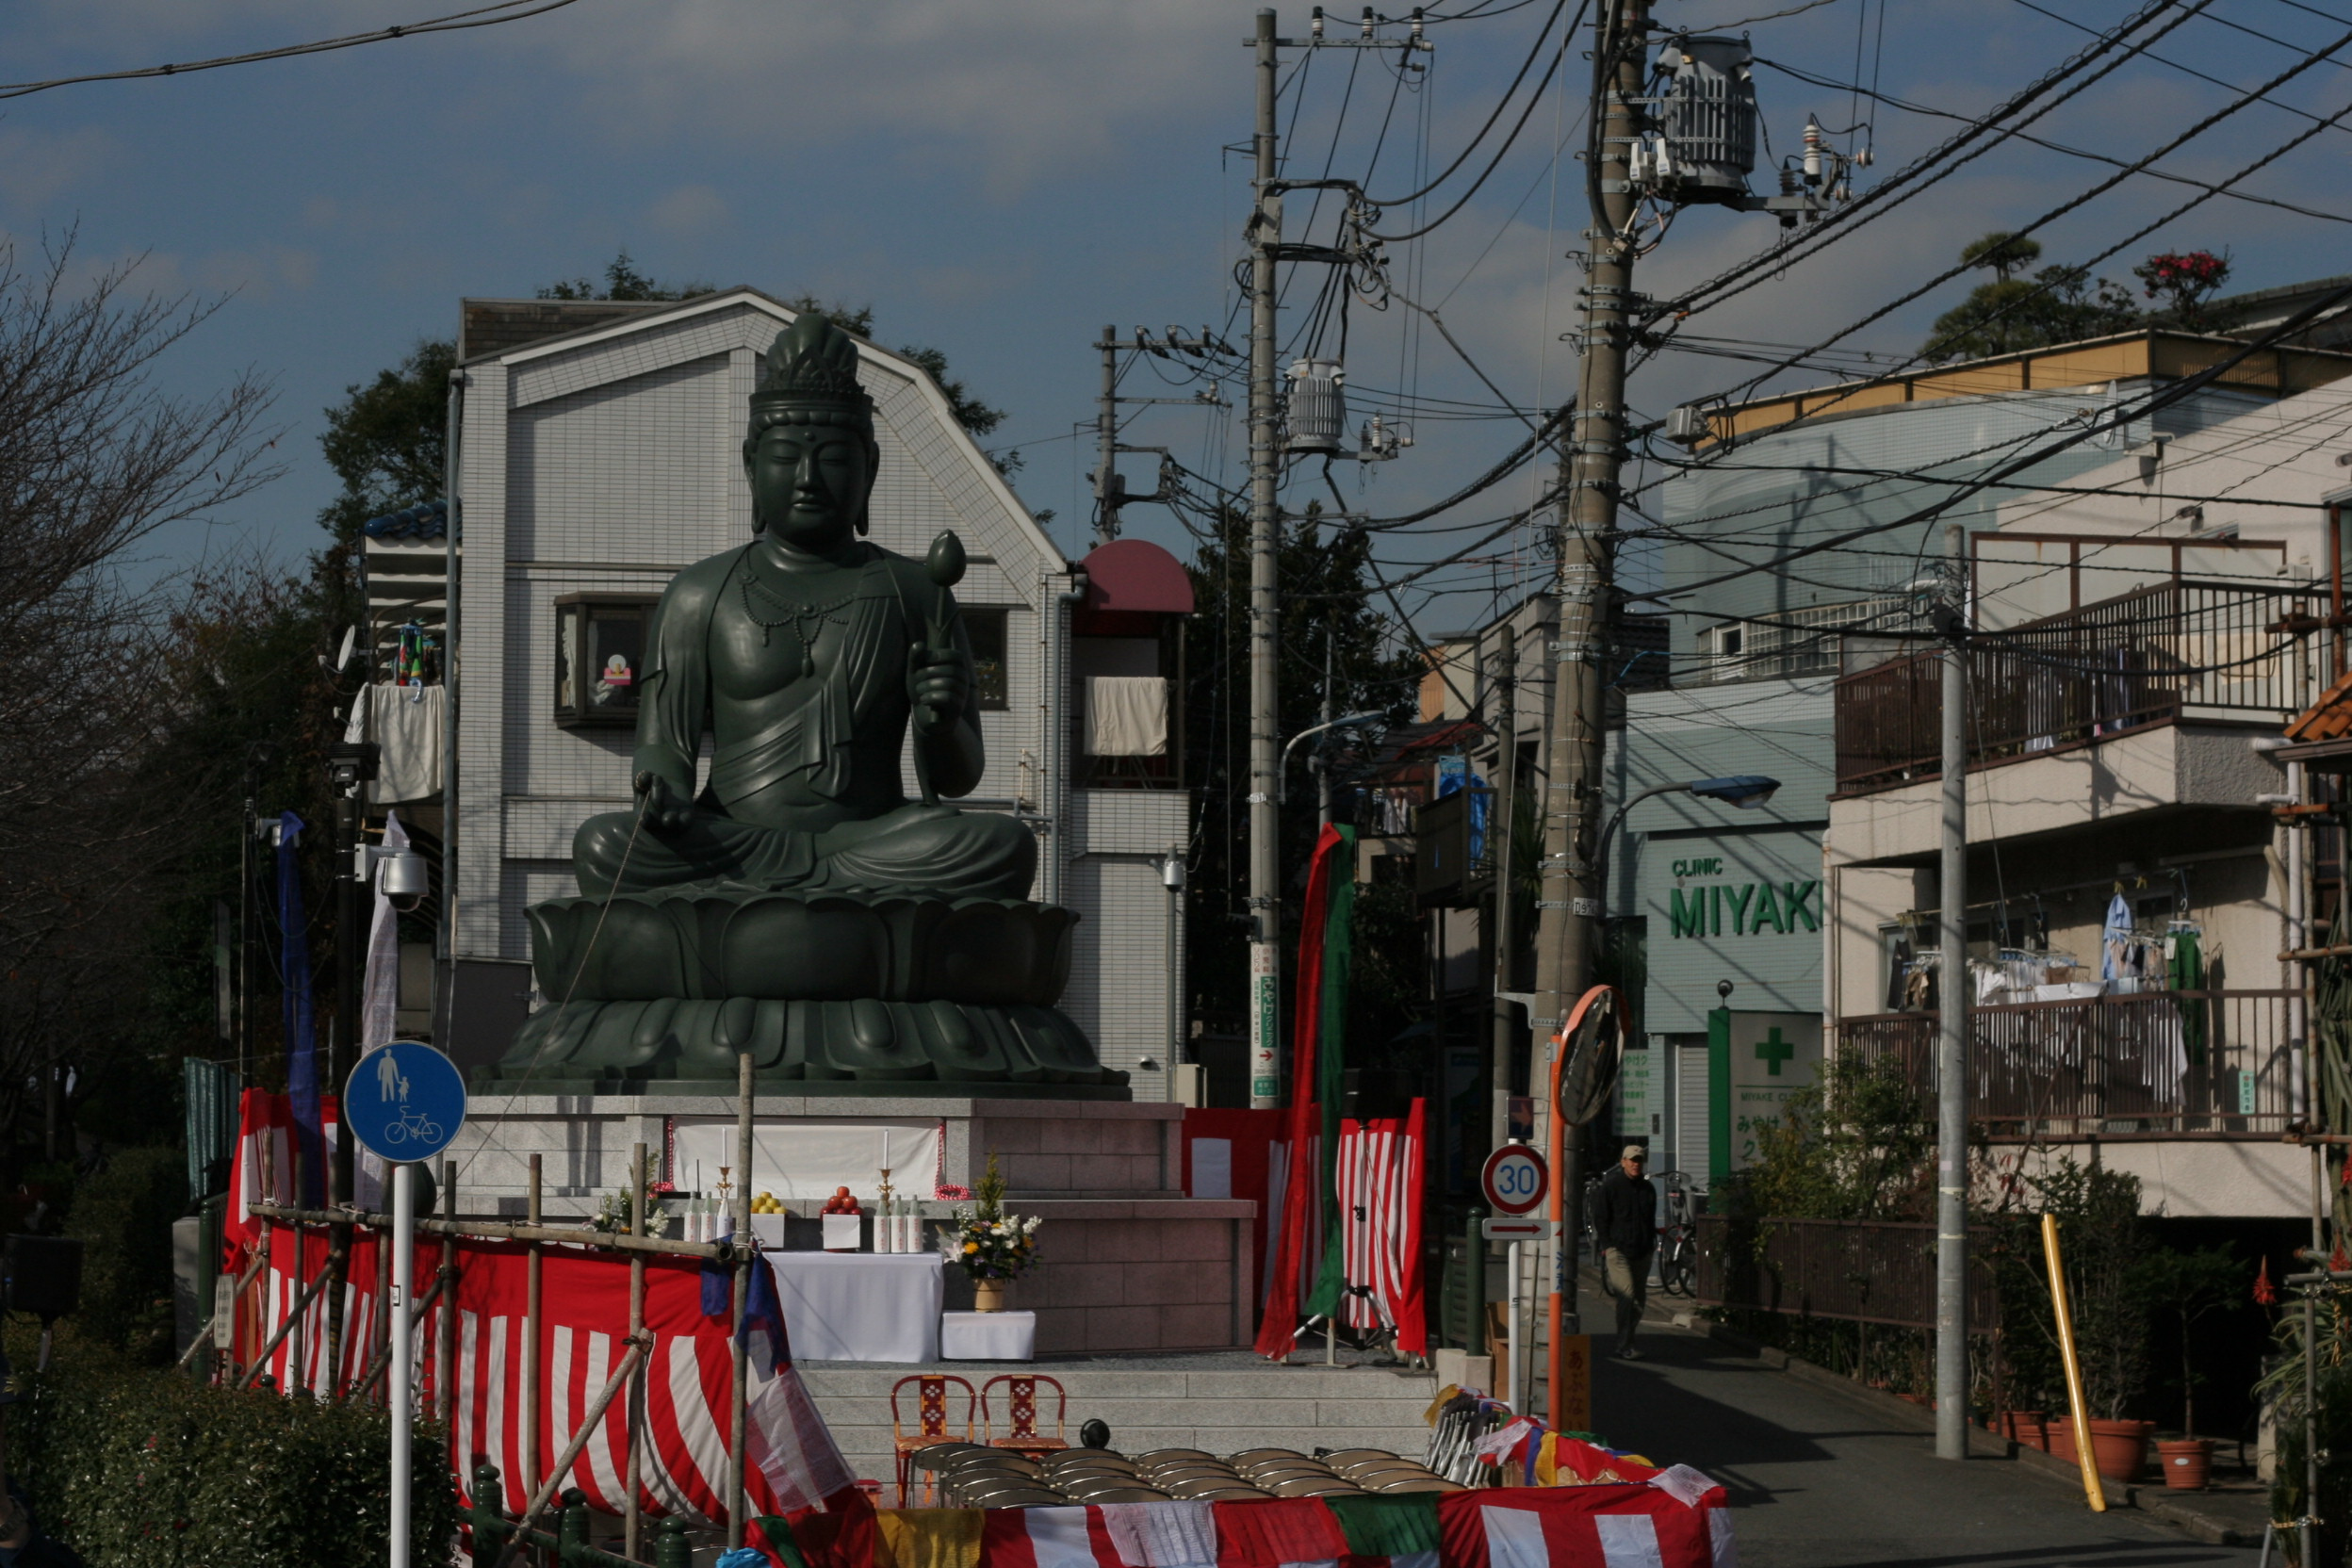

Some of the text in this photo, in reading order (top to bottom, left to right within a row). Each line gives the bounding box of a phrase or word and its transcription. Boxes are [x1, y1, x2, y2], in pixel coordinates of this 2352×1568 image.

[1673, 858, 1723, 877] CLINIC
[1671, 880, 1823, 939] MIYAK
[1741, 1092, 1772, 1102] MIYAKE
[1499, 1165, 1534, 1195] 30
